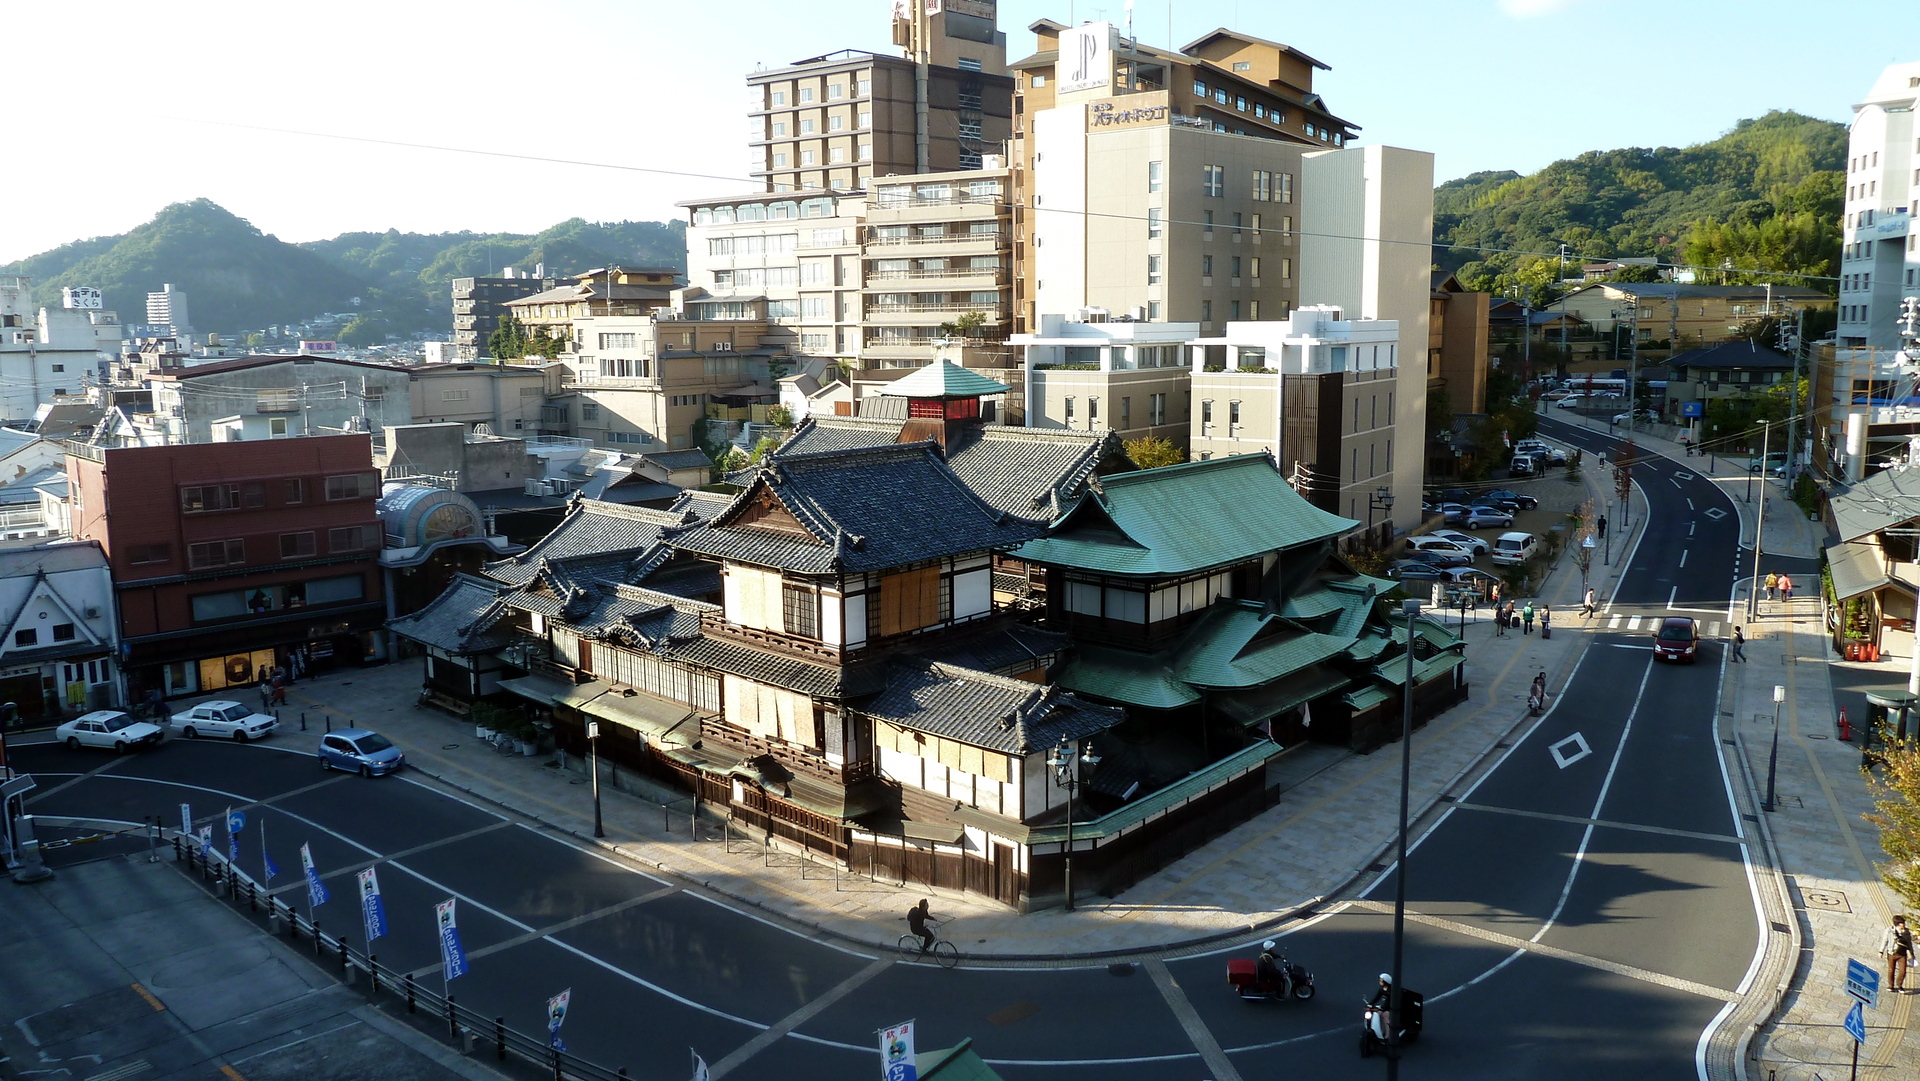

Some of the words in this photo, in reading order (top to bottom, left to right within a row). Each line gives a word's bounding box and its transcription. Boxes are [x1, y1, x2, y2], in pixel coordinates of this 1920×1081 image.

[71, 288, 100, 298] ホテル
[72, 298, 99, 307] さくら
[886, 1025, 909, 1040] 歓迎
